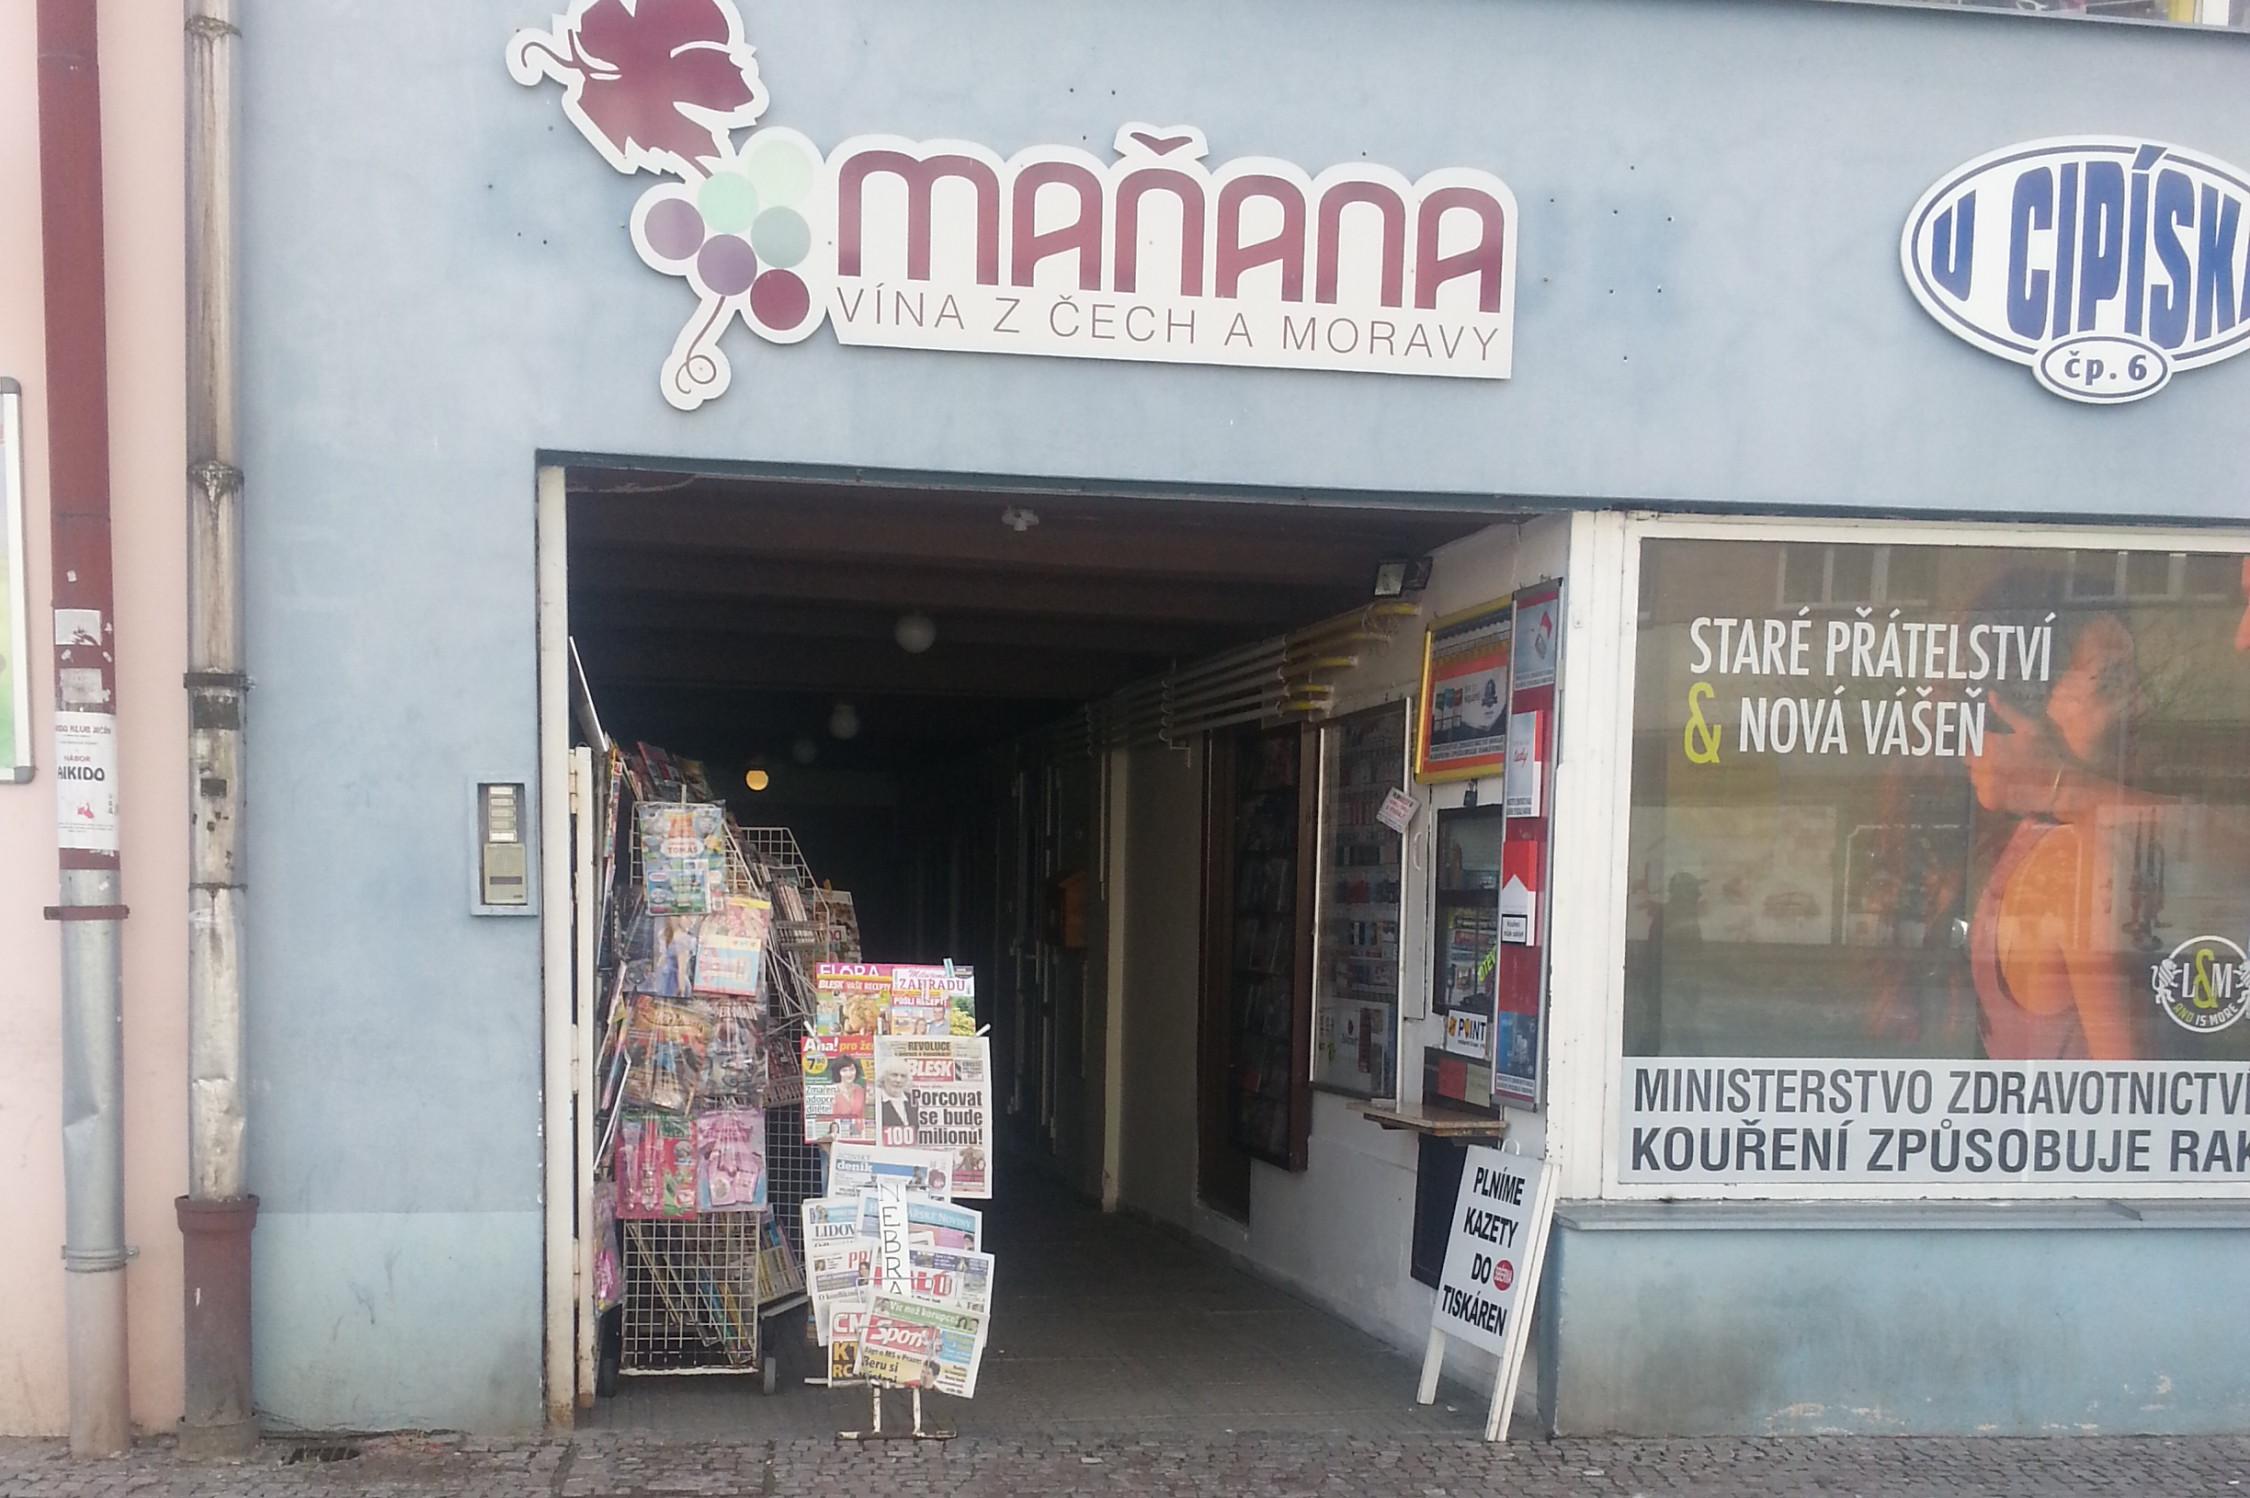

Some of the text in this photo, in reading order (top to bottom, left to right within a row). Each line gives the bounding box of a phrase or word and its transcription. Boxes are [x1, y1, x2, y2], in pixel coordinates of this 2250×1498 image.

[1931, 144, 2250, 350] U CIPÍSK
[836, 284, 1500, 362] VÍNA Z ČECH A MORAVY
[2064, 351, 2147, 385] čp. 6
[1689, 607, 2056, 682] STARÉ PŘÁTELSTVÍ
[1684, 682, 1987, 764] & NOVÁ VÁŠEŇ
[57, 766, 105, 781] AIKIDO
[2195, 1014, 2207, 1027] IS
[2209, 1002, 2239, 1026] MORE
[908, 1041, 952, 1051] REVOLUCE
[912, 1088, 983, 1107] Porcovat
[1634, 1068, 1932, 1114] MINISTERSTVO
[919, 1108, 983, 1126] se bude
[884, 1127, 914, 1145] 100
[1631, 1119, 1854, 1172] KOUŘENÍ
[1867, 1118, 2151, 1173] ZPŮSOBUJE
[1473, 1166, 1525, 1206] PLNÍME
[1463, 1207, 1518, 1248] KAZETY
[1471, 1253, 1492, 1285] DO
[1441, 1285, 1507, 1336] TISKÁREN
[862, 1355, 900, 1373] Beru si
